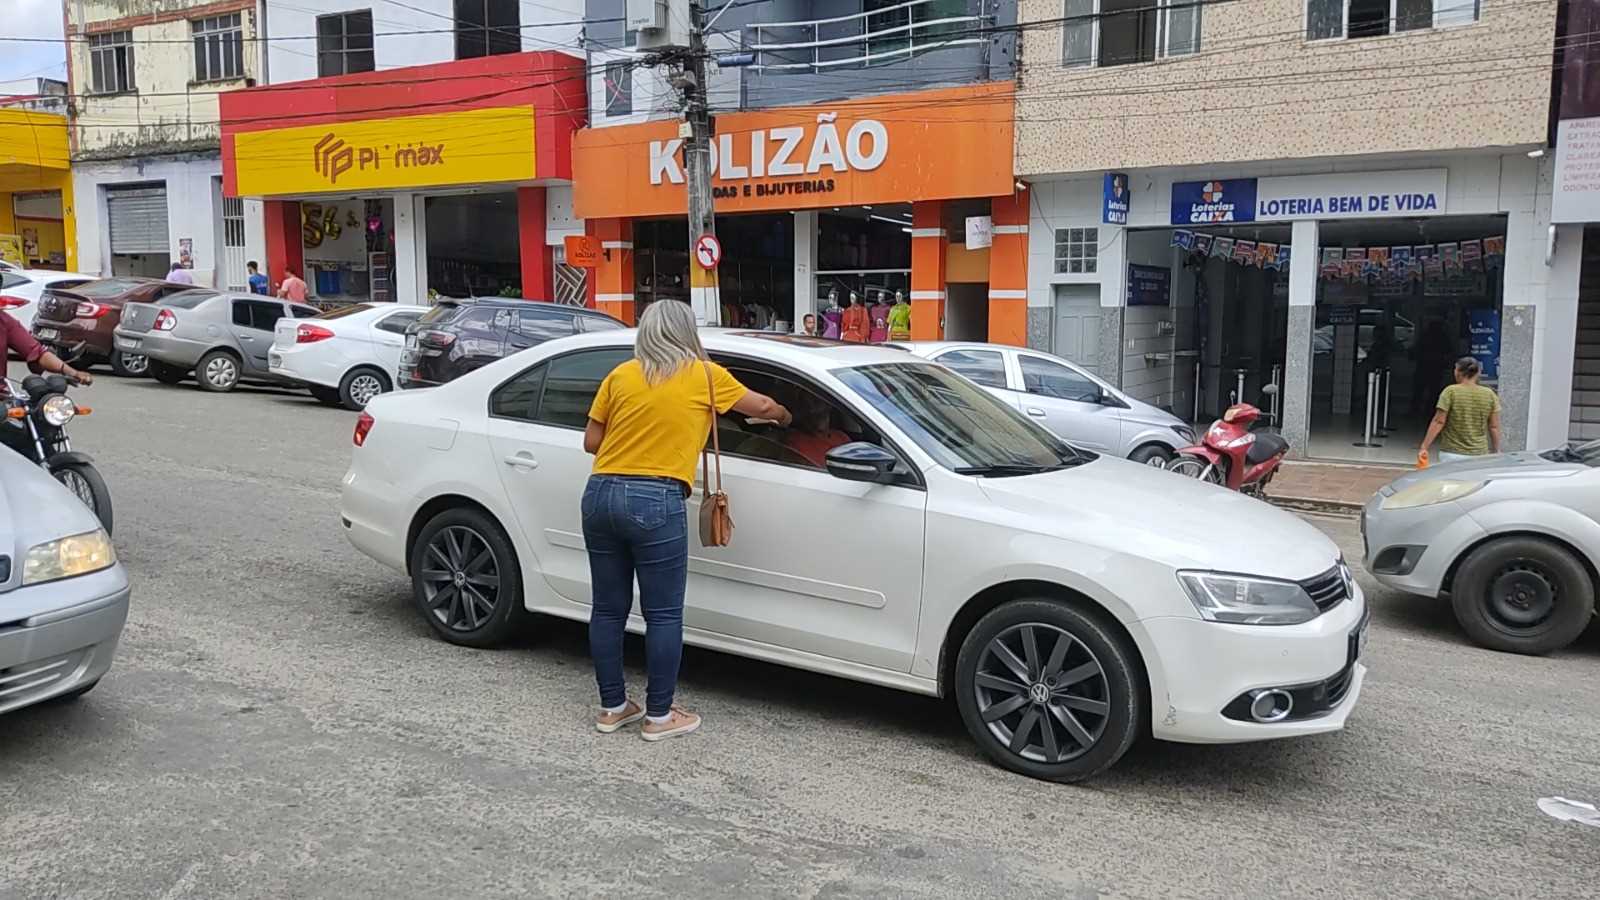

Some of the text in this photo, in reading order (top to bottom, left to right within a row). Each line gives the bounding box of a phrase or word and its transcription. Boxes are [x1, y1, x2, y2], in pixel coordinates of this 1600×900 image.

[713, 179, 835, 198] DAS E BIJUTERIAS
[1191, 202, 1234, 213] Loterias
[1260, 193, 1437, 215] LOTERIA BEM DE VIDA
[1190, 211, 1234, 222] CAIXA
